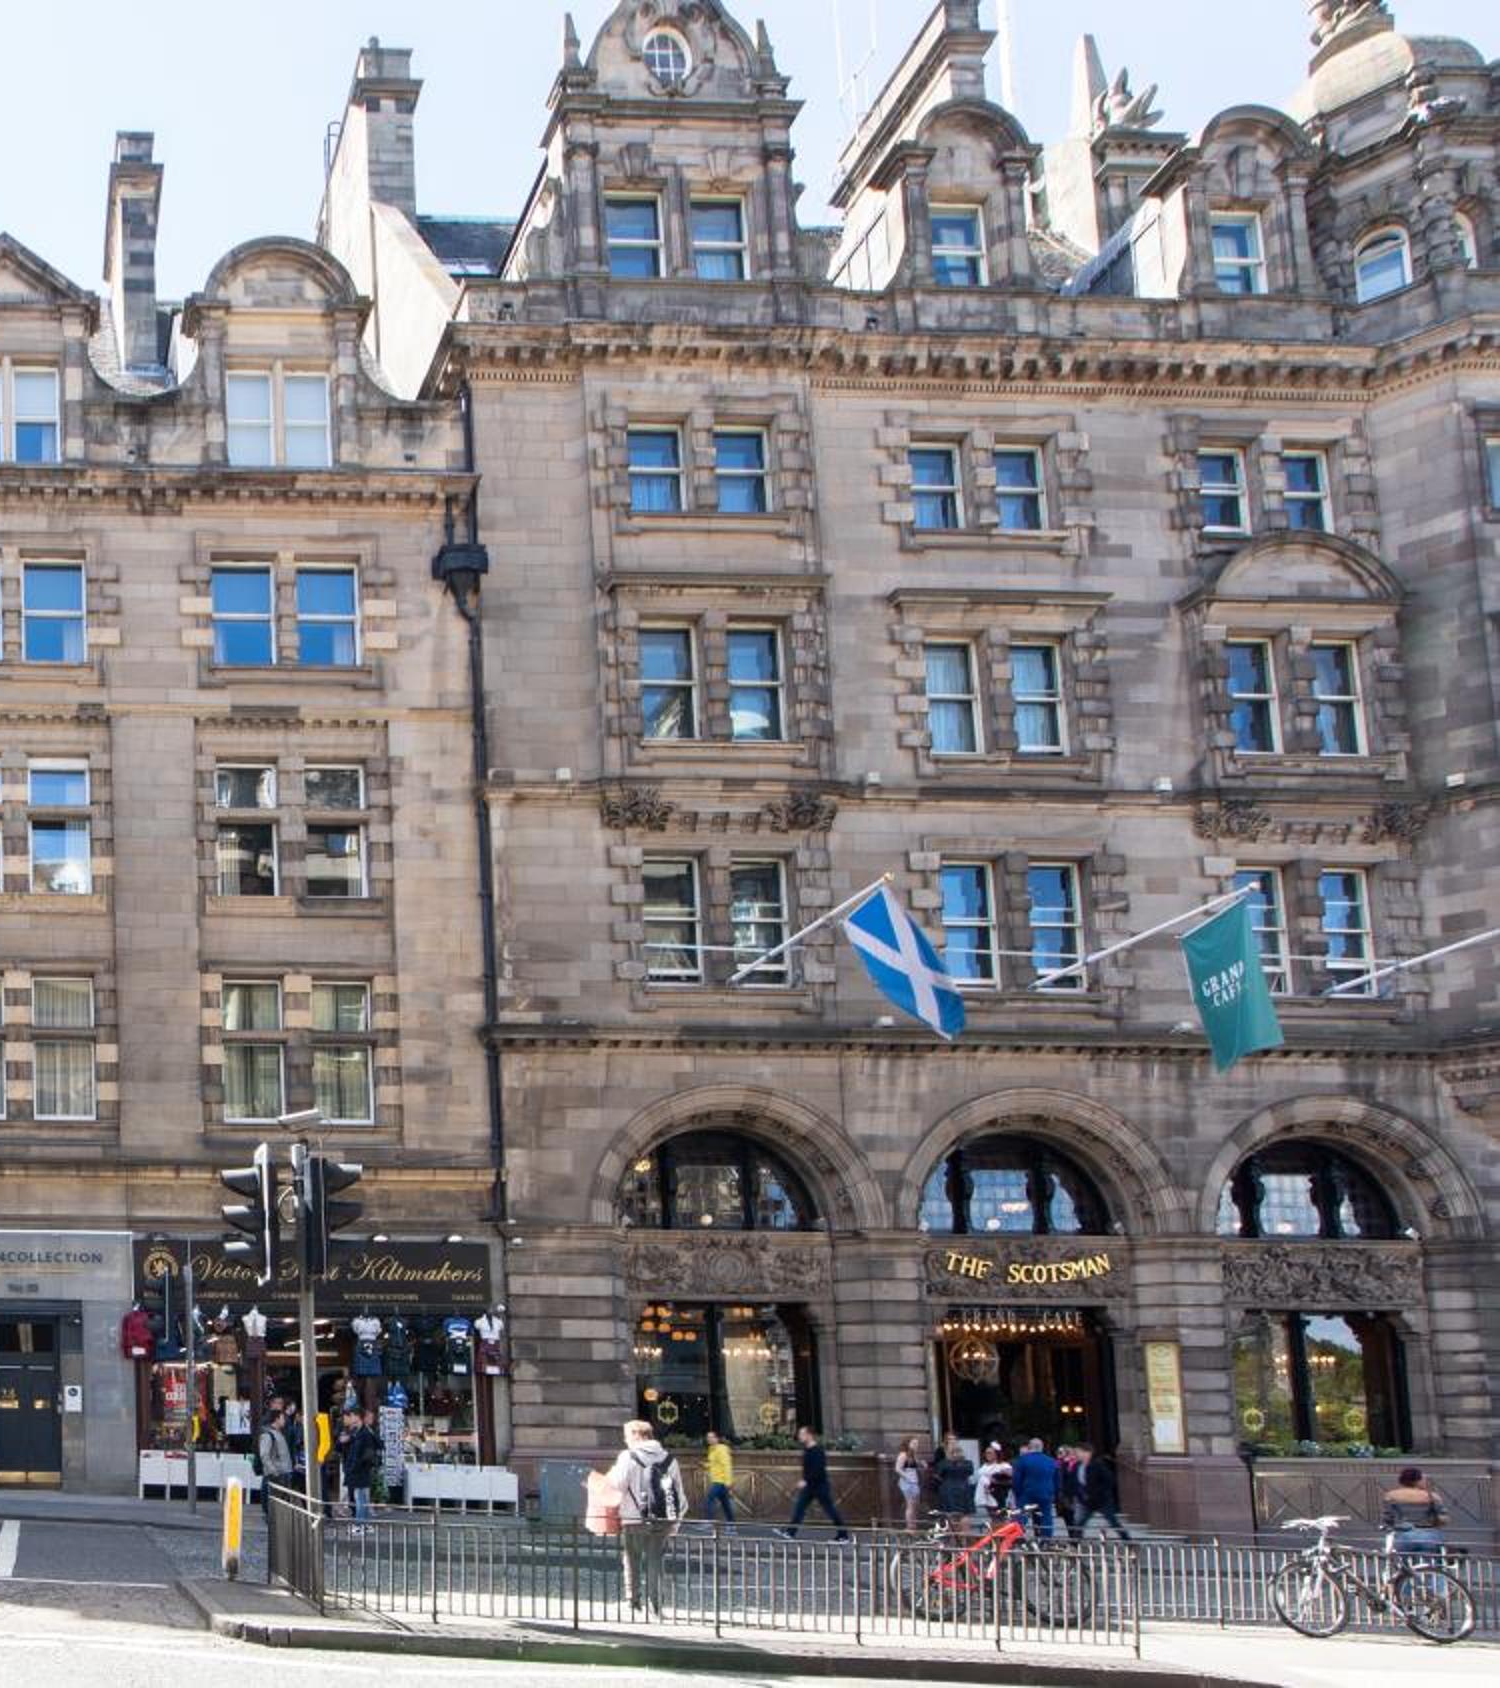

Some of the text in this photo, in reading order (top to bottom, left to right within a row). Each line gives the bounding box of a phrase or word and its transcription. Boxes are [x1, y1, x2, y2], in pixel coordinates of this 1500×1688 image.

[348, 1252, 485, 1282] Kiltmakers
[946, 1252, 1111, 1284] THE SCOTSMAN
